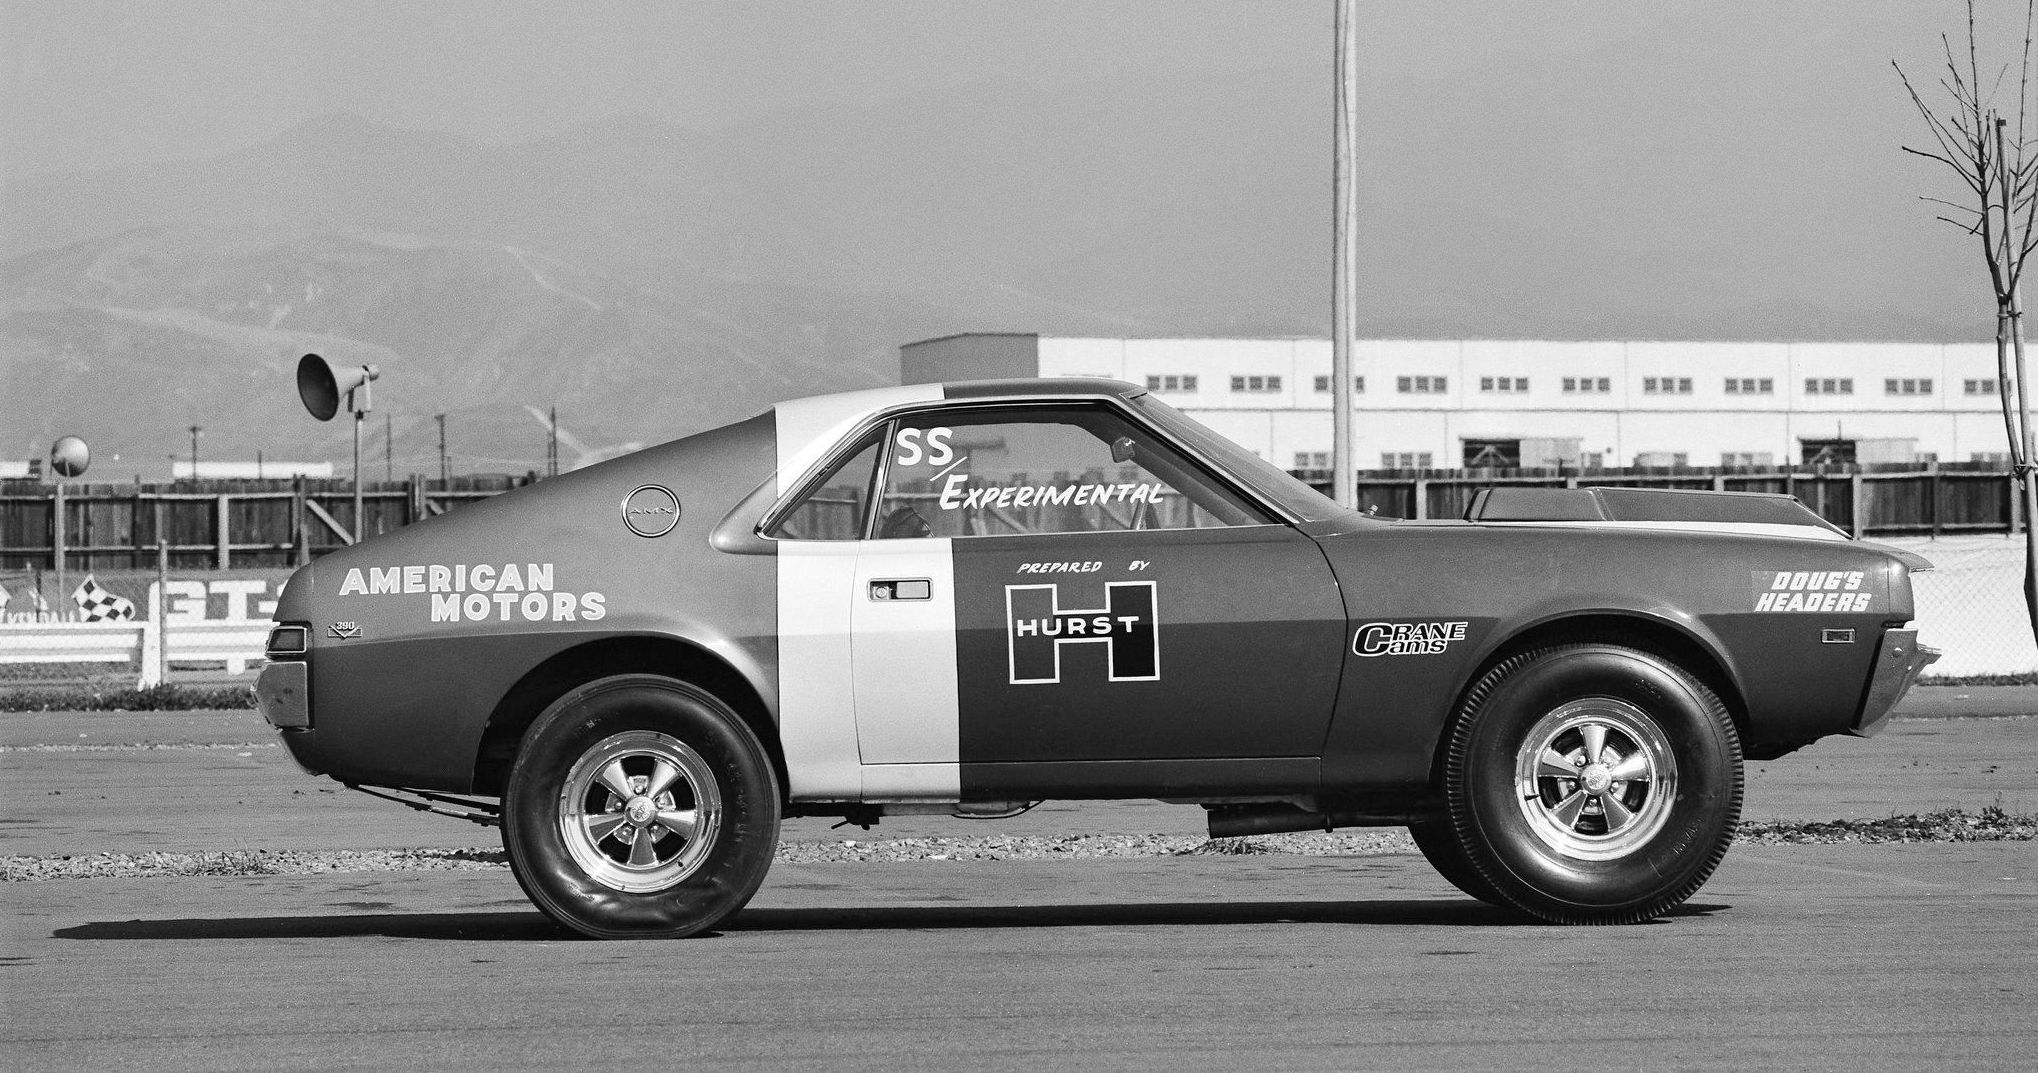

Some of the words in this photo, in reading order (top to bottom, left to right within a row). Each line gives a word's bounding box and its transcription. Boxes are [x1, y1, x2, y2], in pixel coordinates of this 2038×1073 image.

[939, 473, 1165, 510] EXPERIMENTAL
[1016, 561, 1103, 574] PREPARED
[1128, 560, 1151, 571] BY
[338, 563, 554, 596] AMERICAN
[1771, 571, 1865, 591] DOUG'S
[430, 591, 607, 622] MOTORS
[1754, 592, 1873, 612] HEADERS
[336, 621, 355, 630] 390
[1016, 616, 1140, 637] HURST
[1352, 621, 1469, 657] CRANE
